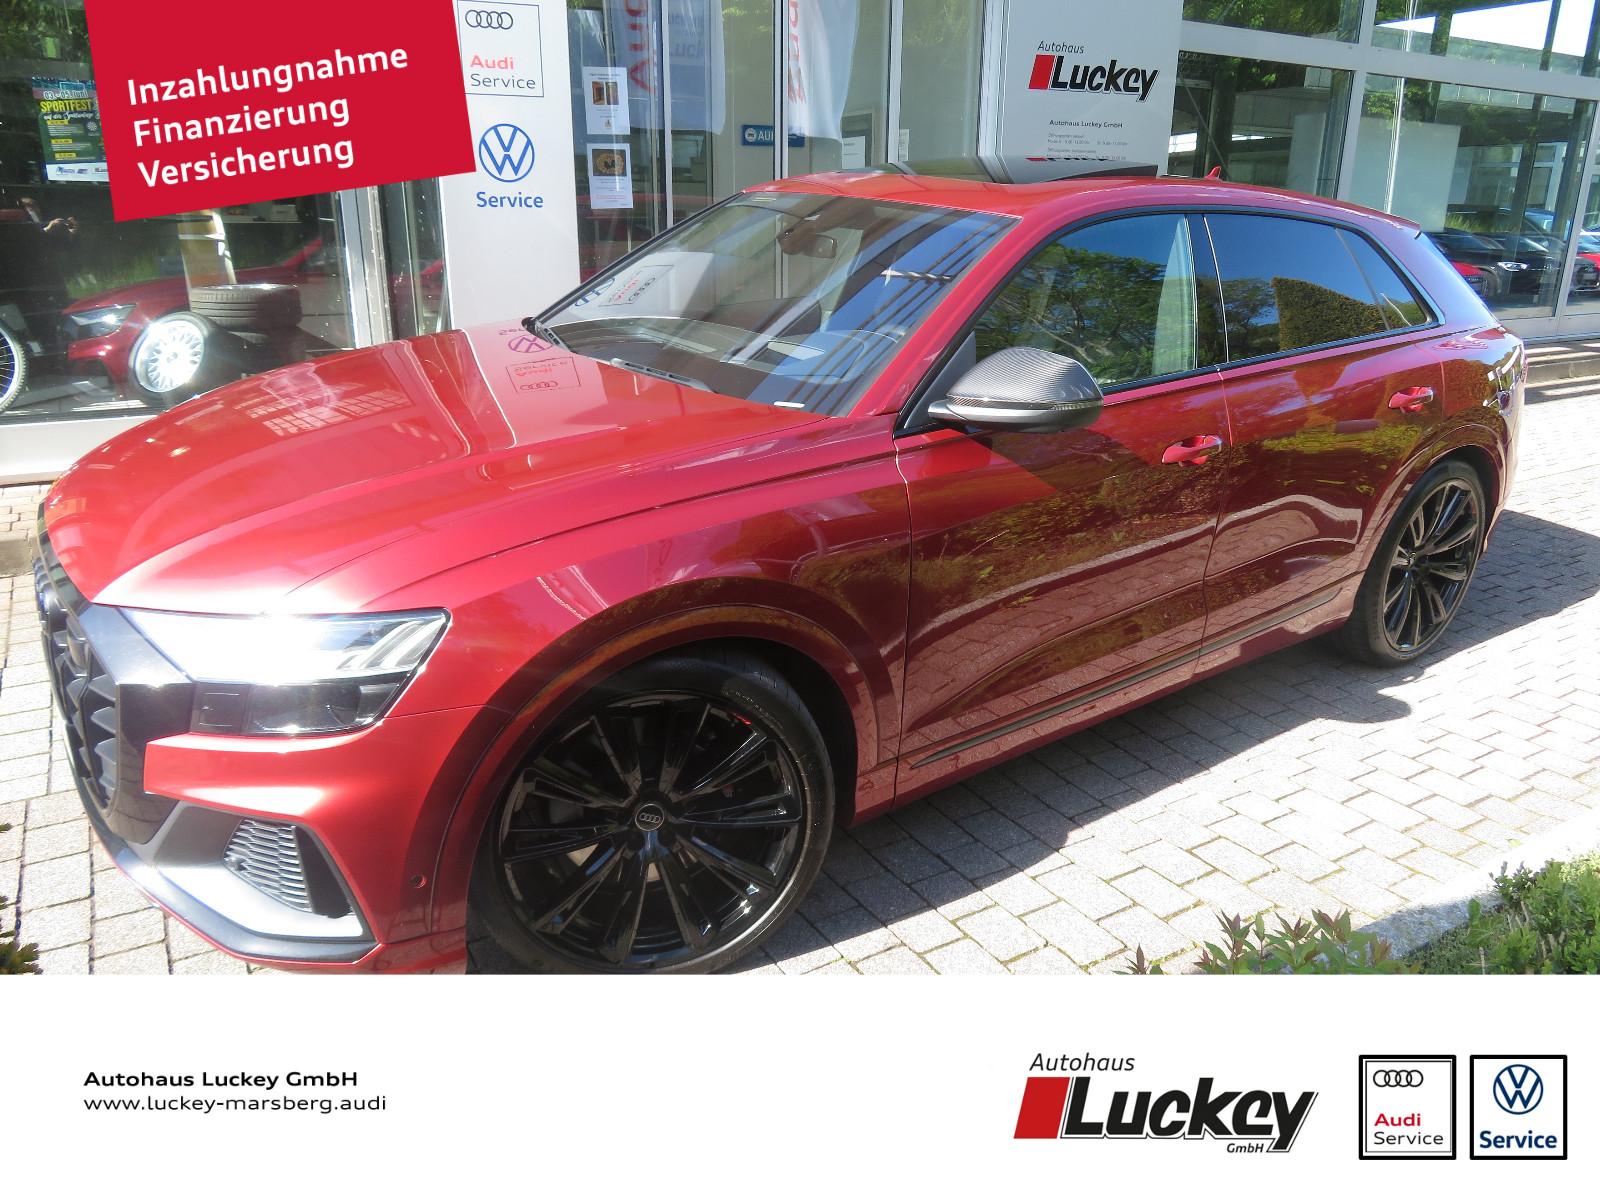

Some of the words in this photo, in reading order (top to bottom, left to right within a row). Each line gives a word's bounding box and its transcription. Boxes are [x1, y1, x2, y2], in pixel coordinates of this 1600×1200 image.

[1037, 40, 1085, 54] Autohaus
[470, 55, 515, 70] Audi
[470, 73, 536, 89] Service
[1050, 56, 1159, 102] Luckey
[40, 99, 92, 113] SPORTFEST
[476, 192, 544, 208] Service
